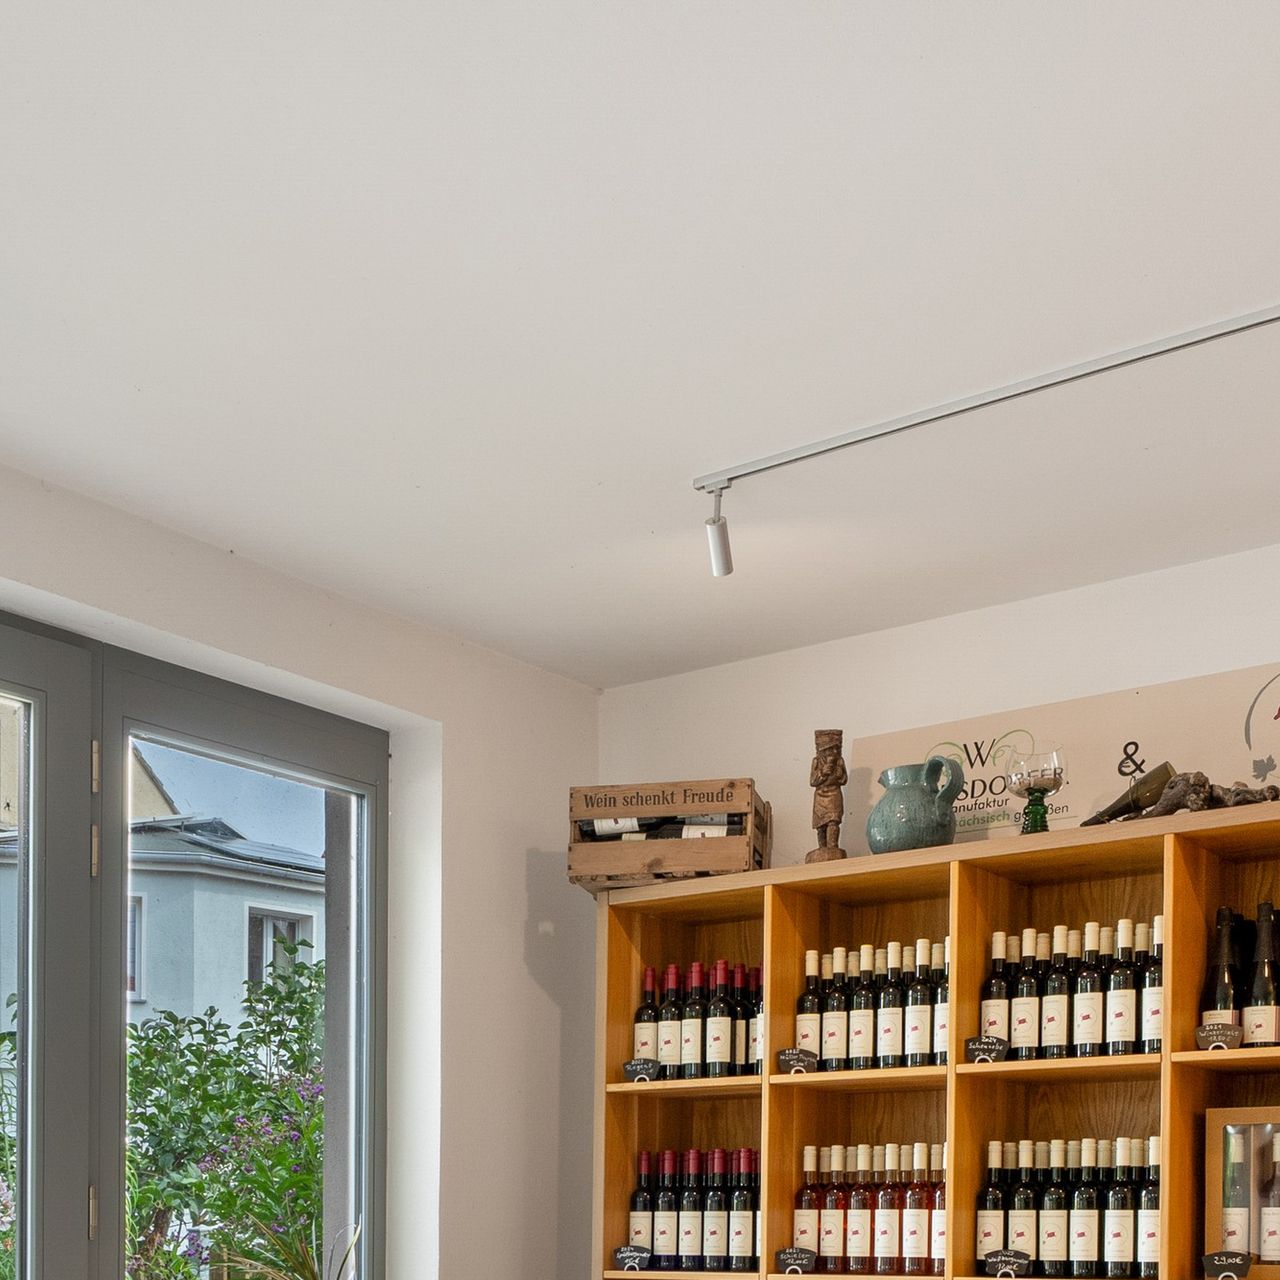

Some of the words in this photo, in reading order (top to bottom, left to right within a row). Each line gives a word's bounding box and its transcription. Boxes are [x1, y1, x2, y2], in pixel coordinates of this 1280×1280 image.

[1118, 741, 1145, 777] &
[583, 793, 617, 809] Wein
[622, 790, 677, 808] schenkt
[683, 787, 734, 804] Freude
[951, 796, 1010, 814] anufaktur
[955, 809, 1011, 829] ächsisch
[625, 1063, 653, 1072] Regent
